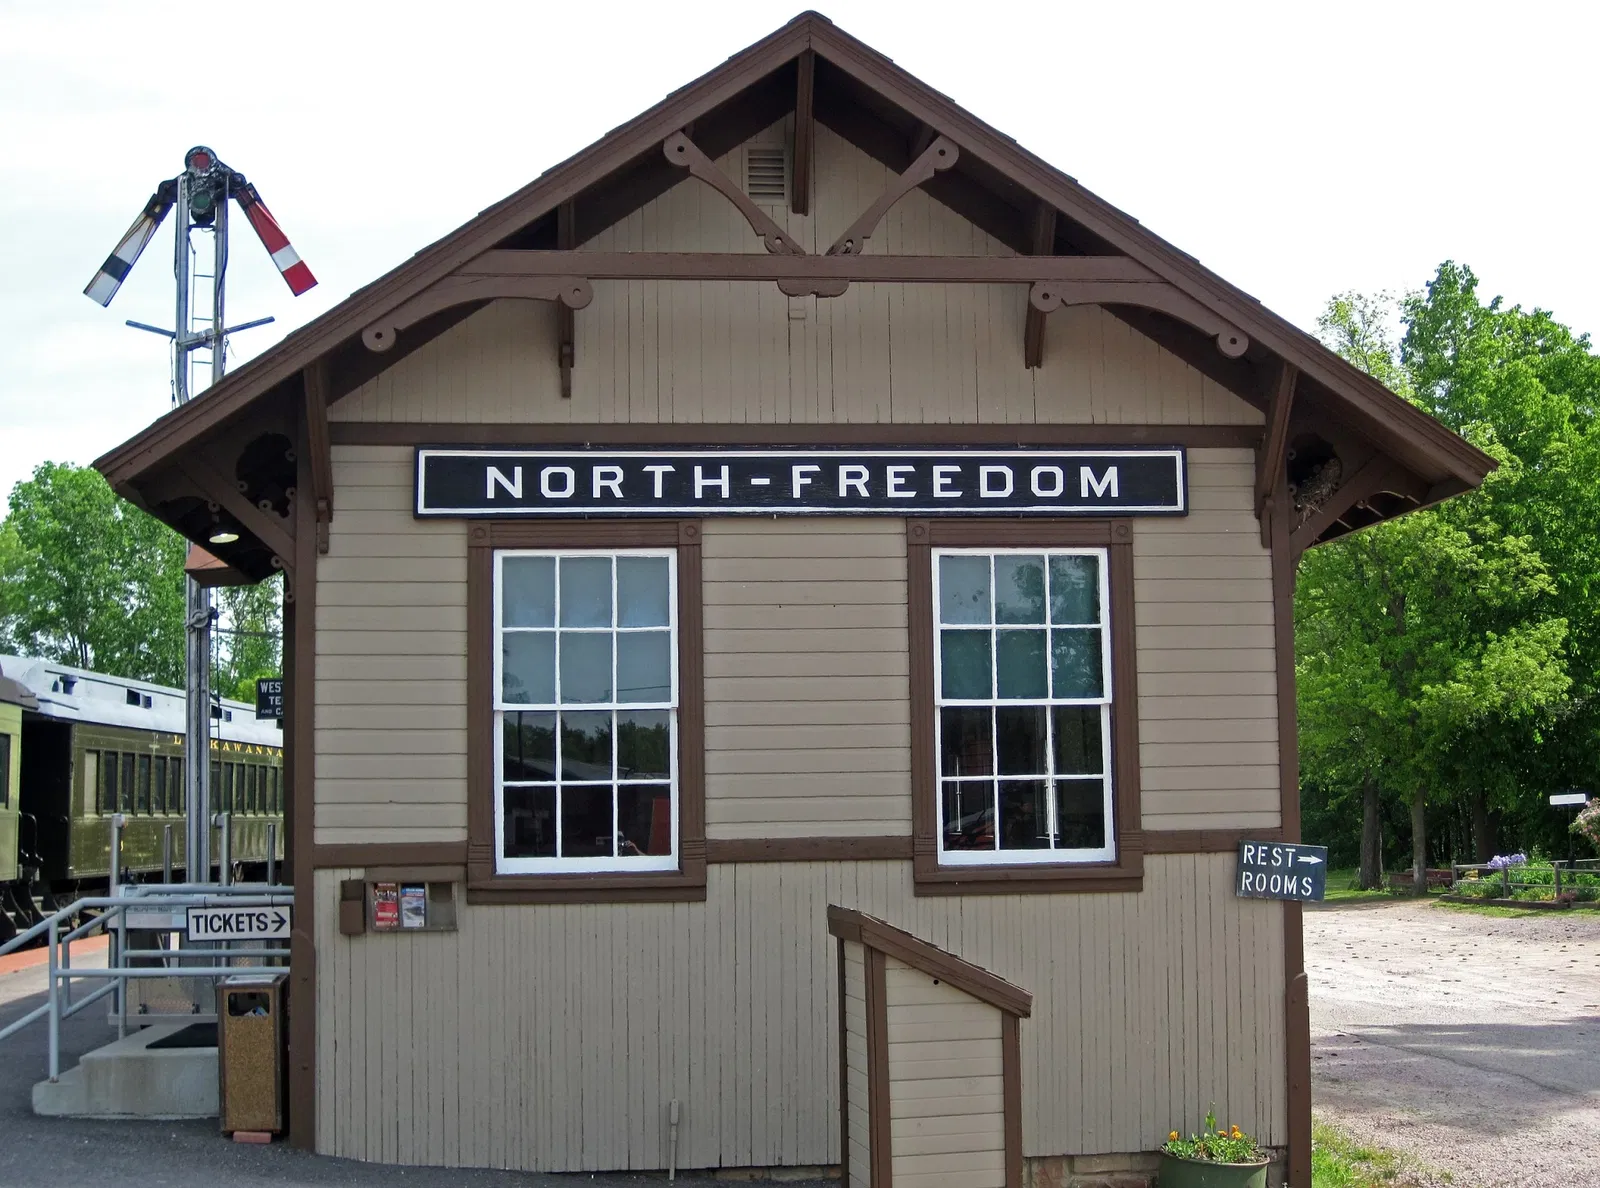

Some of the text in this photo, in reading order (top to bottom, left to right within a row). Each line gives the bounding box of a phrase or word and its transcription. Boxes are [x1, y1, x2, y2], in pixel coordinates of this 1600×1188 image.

[486, 465, 1119, 499] NORTH-FREEDOM
[260, 682, 283, 693] WES
[269, 696, 283, 705] TE
[173, 735, 283, 758] LKAWANNA
[1243, 844, 1296, 867] REST
[1241, 871, 1312, 896] ROOMS
[192, 911, 268, 934] TICKETS
